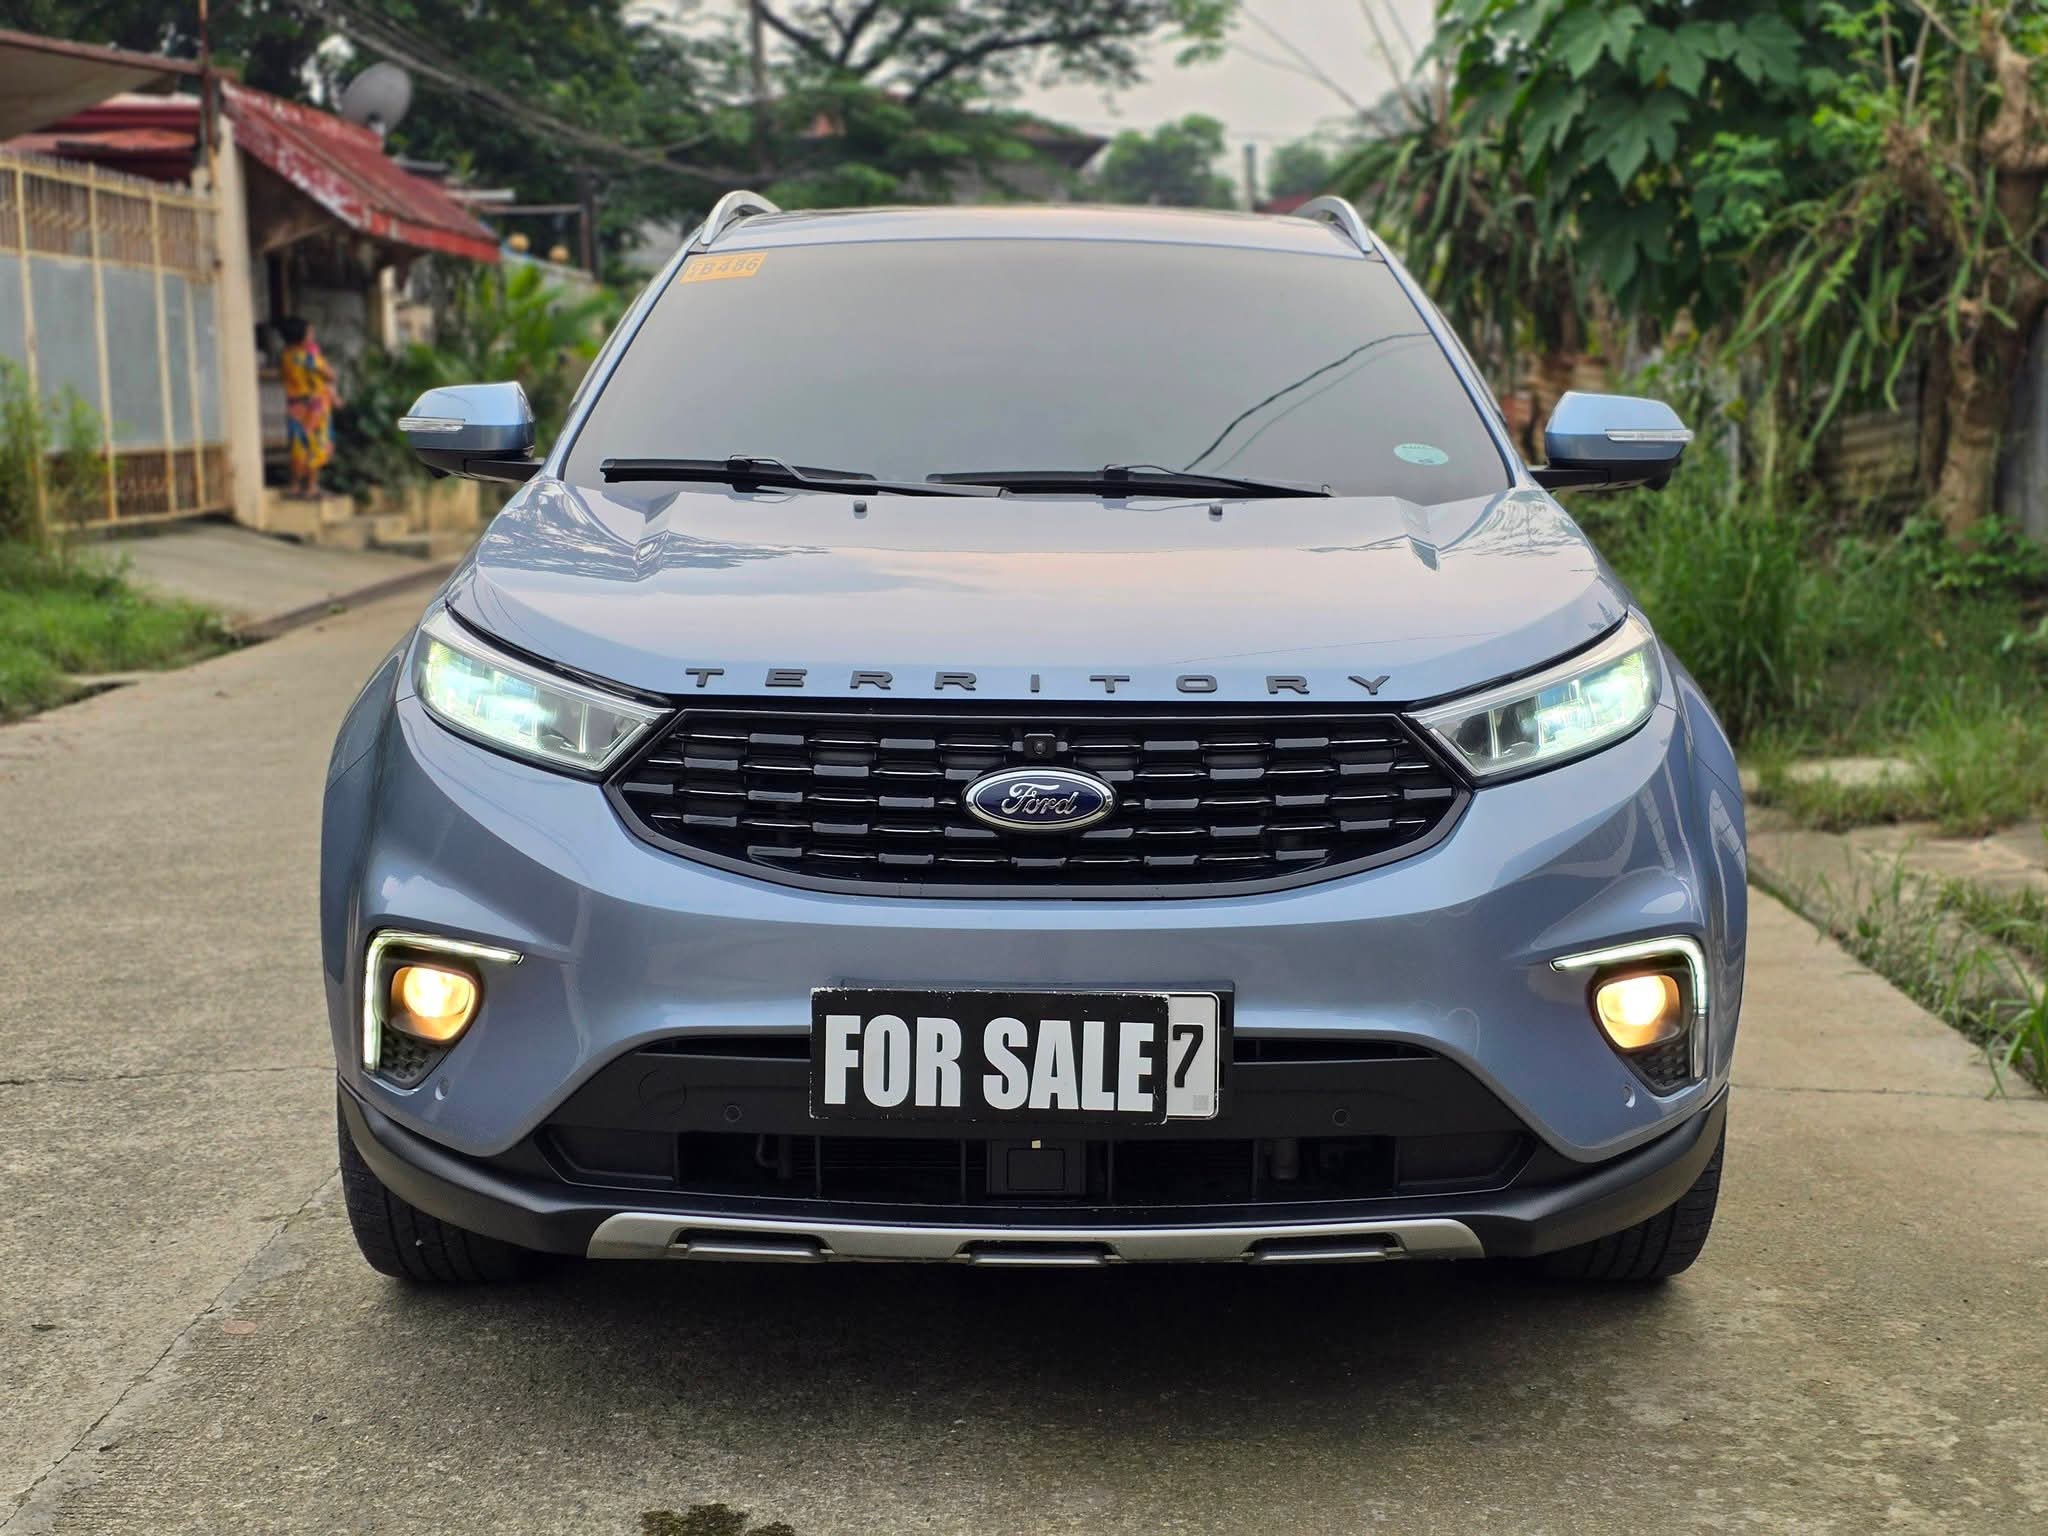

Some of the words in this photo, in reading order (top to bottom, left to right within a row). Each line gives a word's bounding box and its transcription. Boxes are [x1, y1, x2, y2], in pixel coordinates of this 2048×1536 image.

[685, 667, 1391, 696] TERRITORY
[1001, 782, 1079, 815] Ford
[823, 1014, 962, 1108] FOR
[983, 1016, 1155, 1112] SALE
[1172, 1023, 1204, 1088] 7
